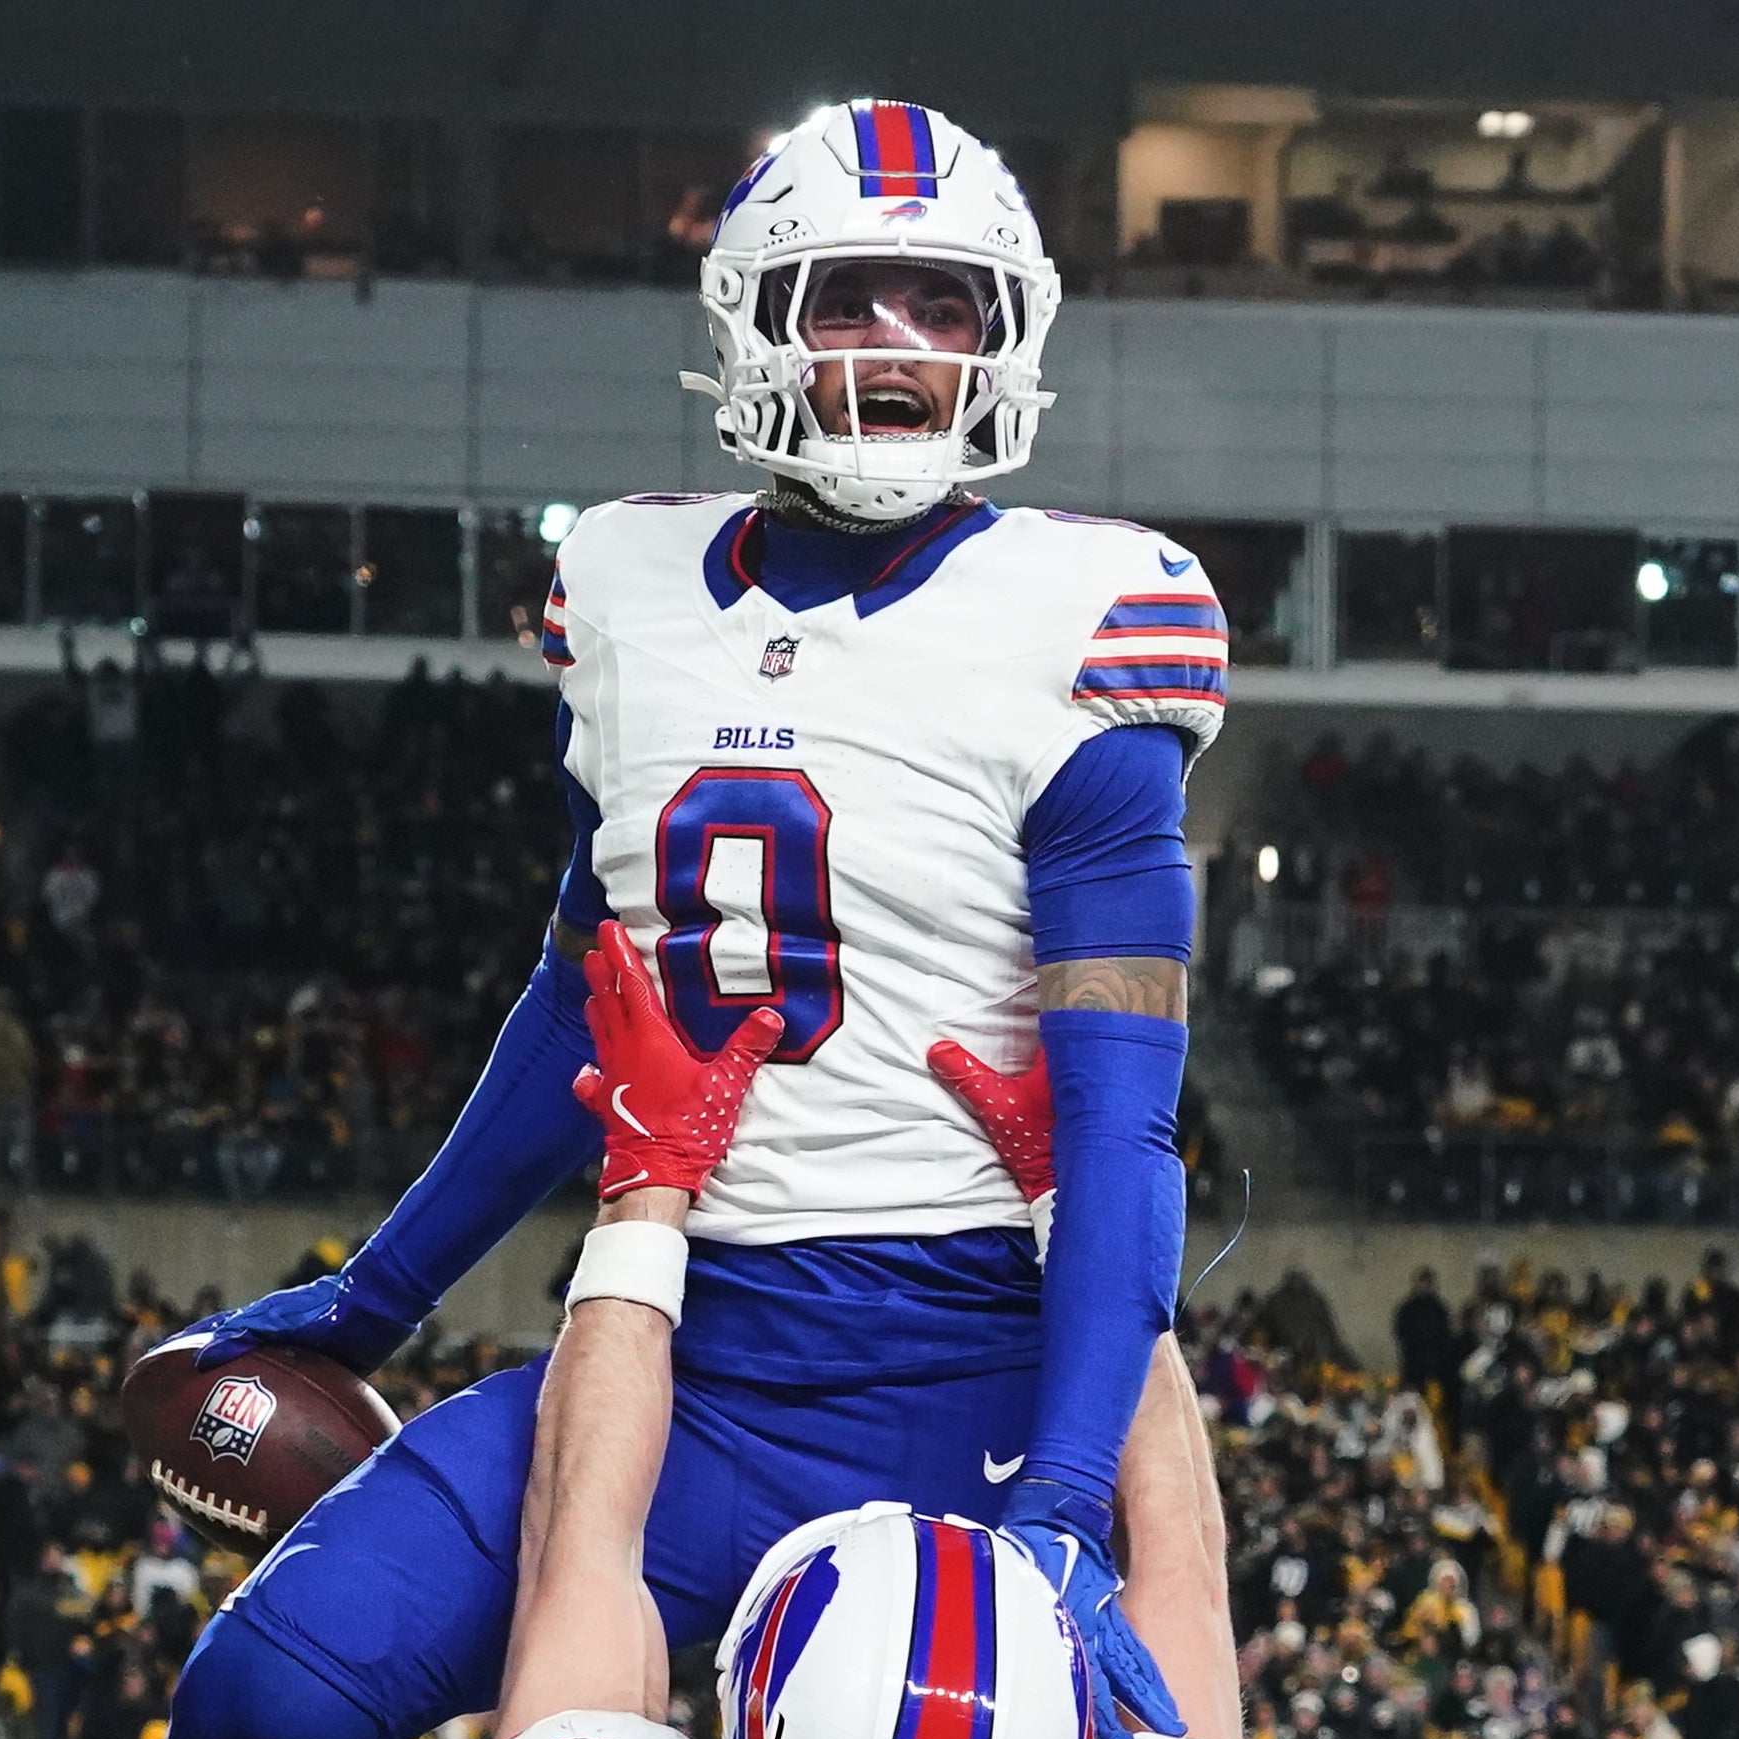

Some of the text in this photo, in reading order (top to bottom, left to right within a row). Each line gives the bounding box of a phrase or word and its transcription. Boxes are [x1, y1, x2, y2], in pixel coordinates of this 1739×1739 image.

[712, 726, 795, 750] BILLS
[655, 766, 844, 1065] 0
[214, 1383, 267, 1431] NFL
